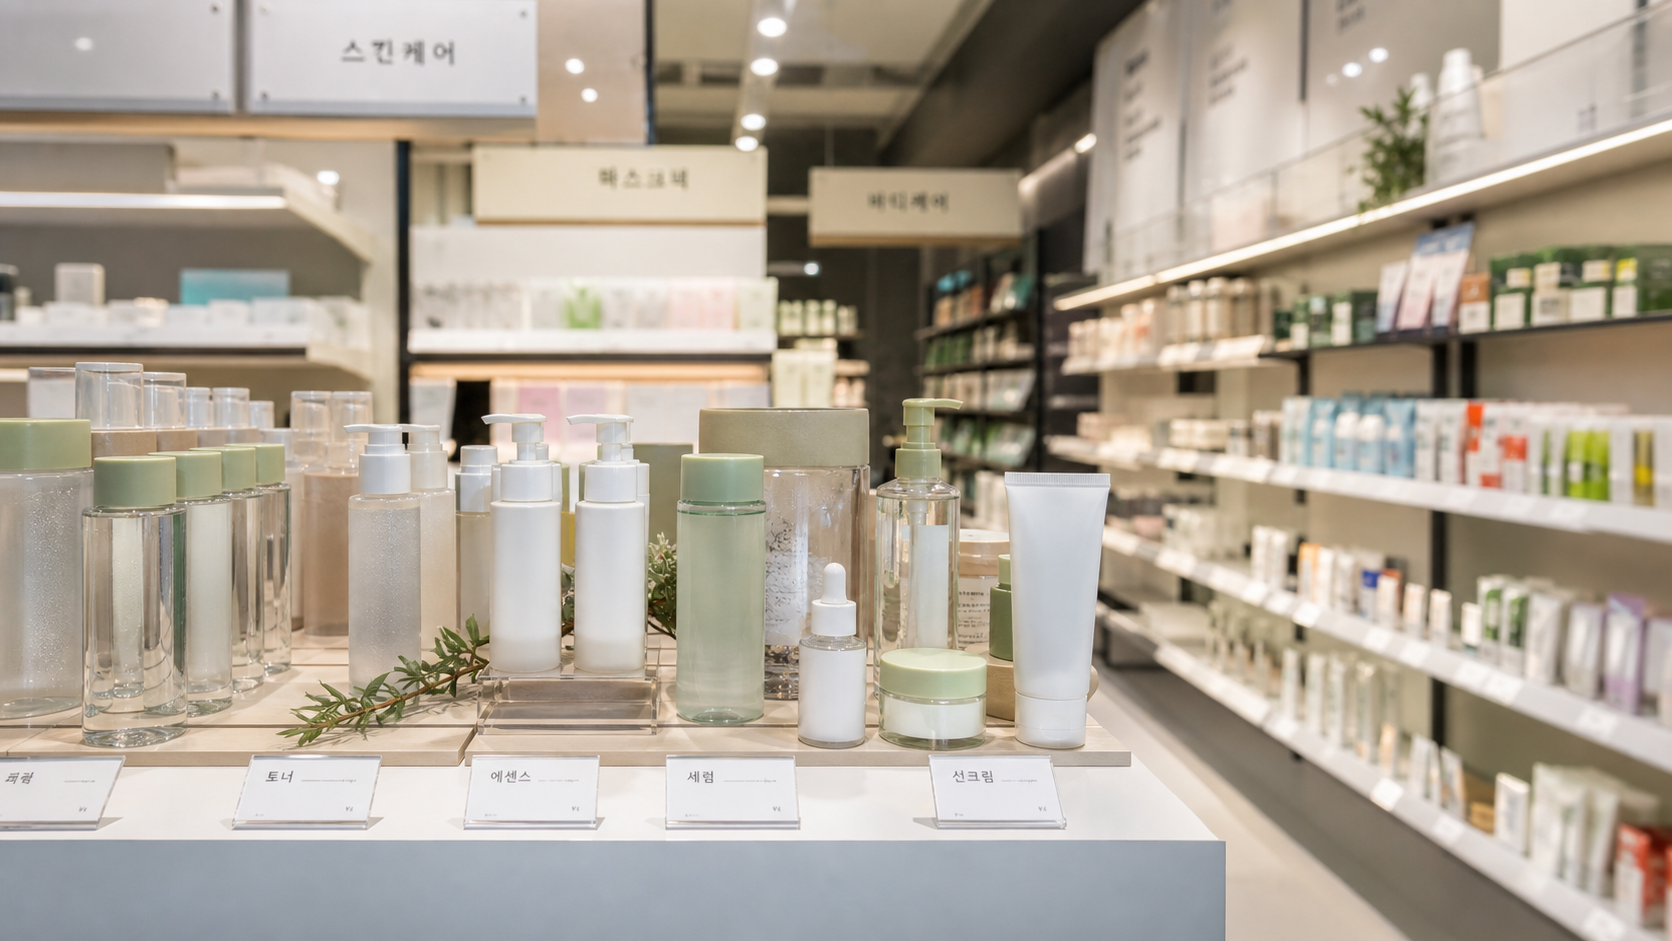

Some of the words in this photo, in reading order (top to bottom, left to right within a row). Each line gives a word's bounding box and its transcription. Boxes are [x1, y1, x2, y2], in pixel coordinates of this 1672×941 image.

[265, 770, 294, 783] 토너
[490, 770, 531, 784] 에센스
[687, 770, 714, 784] 세럼
[952, 770, 994, 784] 선크림
